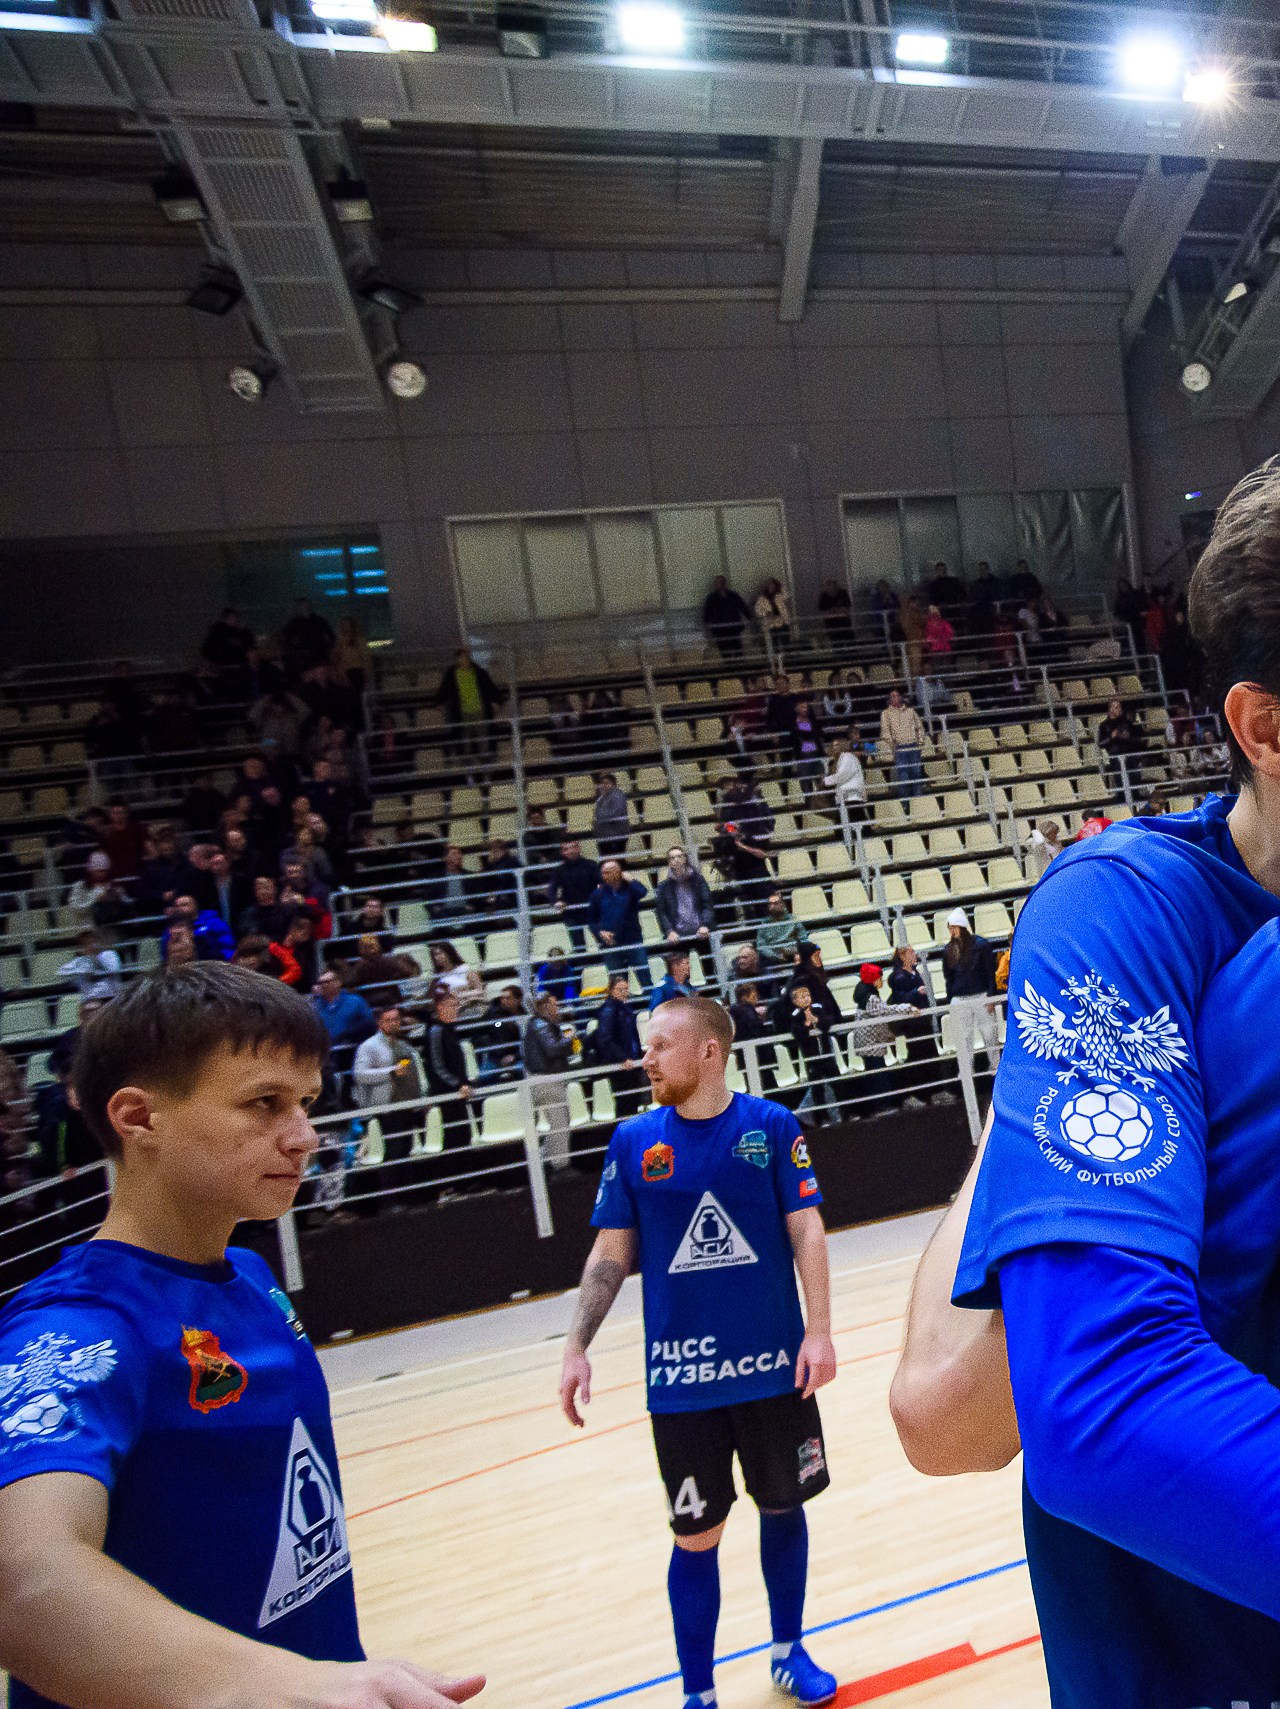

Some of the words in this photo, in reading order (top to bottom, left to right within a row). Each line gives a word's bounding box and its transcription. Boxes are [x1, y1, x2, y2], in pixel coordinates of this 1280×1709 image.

[1033, 1086, 1073, 1174] РОССИЙСКИЙ
[1077, 1139, 1179, 1186] ФУТБОЛЬНЫЙ
[1155, 1095, 1181, 1138] СОЮЗ
[665, 1474, 708, 1522] 4
